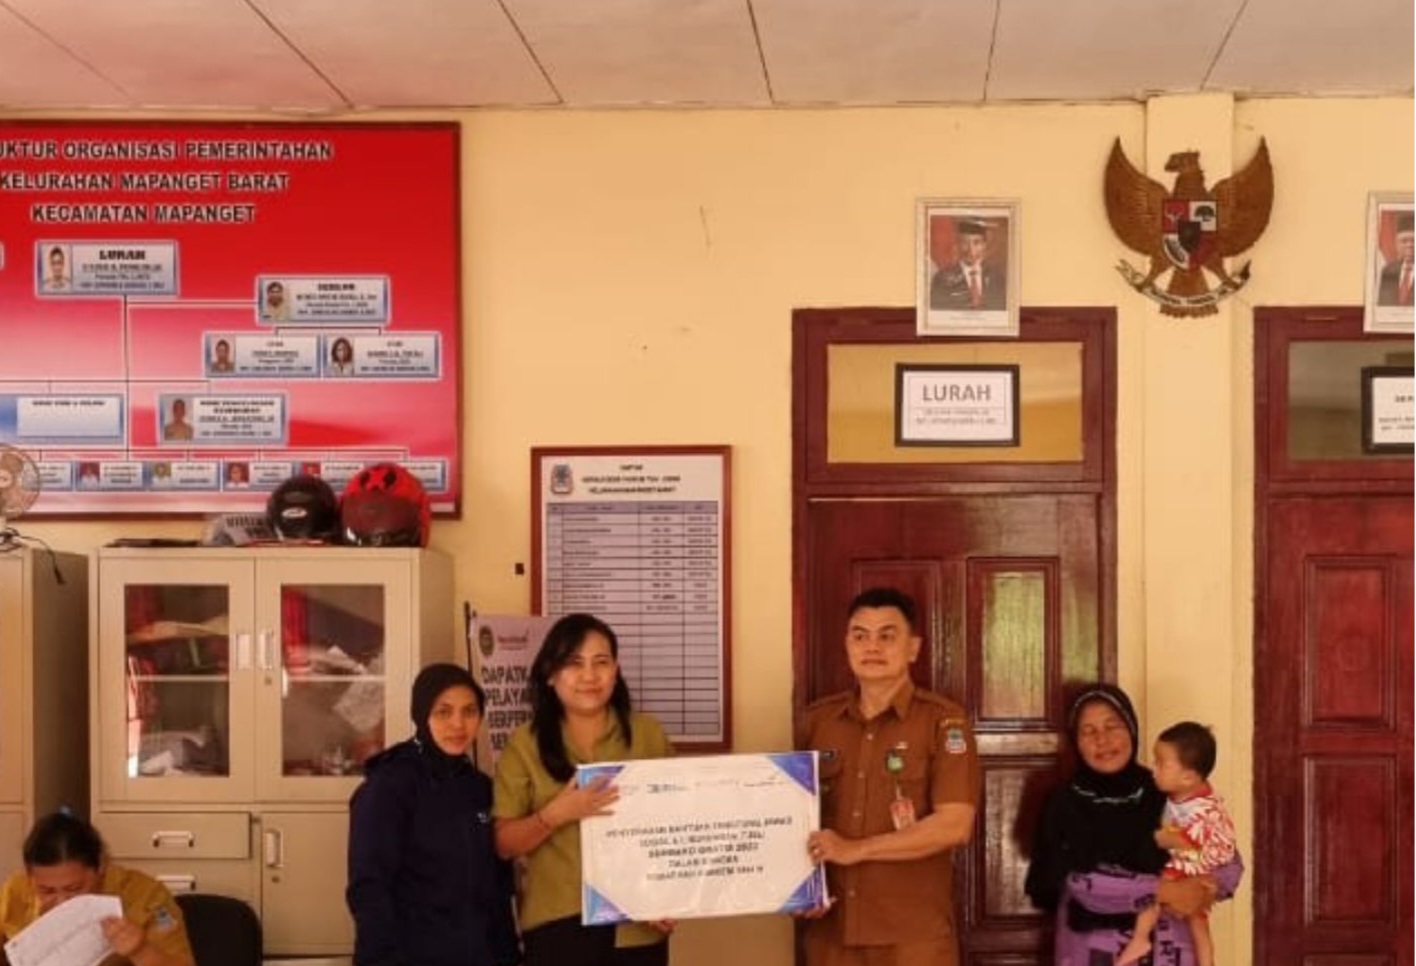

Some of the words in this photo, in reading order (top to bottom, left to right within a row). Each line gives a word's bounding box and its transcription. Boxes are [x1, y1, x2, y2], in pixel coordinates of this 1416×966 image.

[63, 141, 179, 159] ORGANISASI
[185, 141, 332, 159] PEMERINTAHAN
[0, 172, 113, 190] KELURAHAN
[121, 172, 221, 190] MAPANGET
[228, 172, 290, 190] BARAT
[32, 204, 148, 222] KECAMATAN
[154, 203, 256, 222] MAPANGET
[922, 384, 991, 401] LURAH
